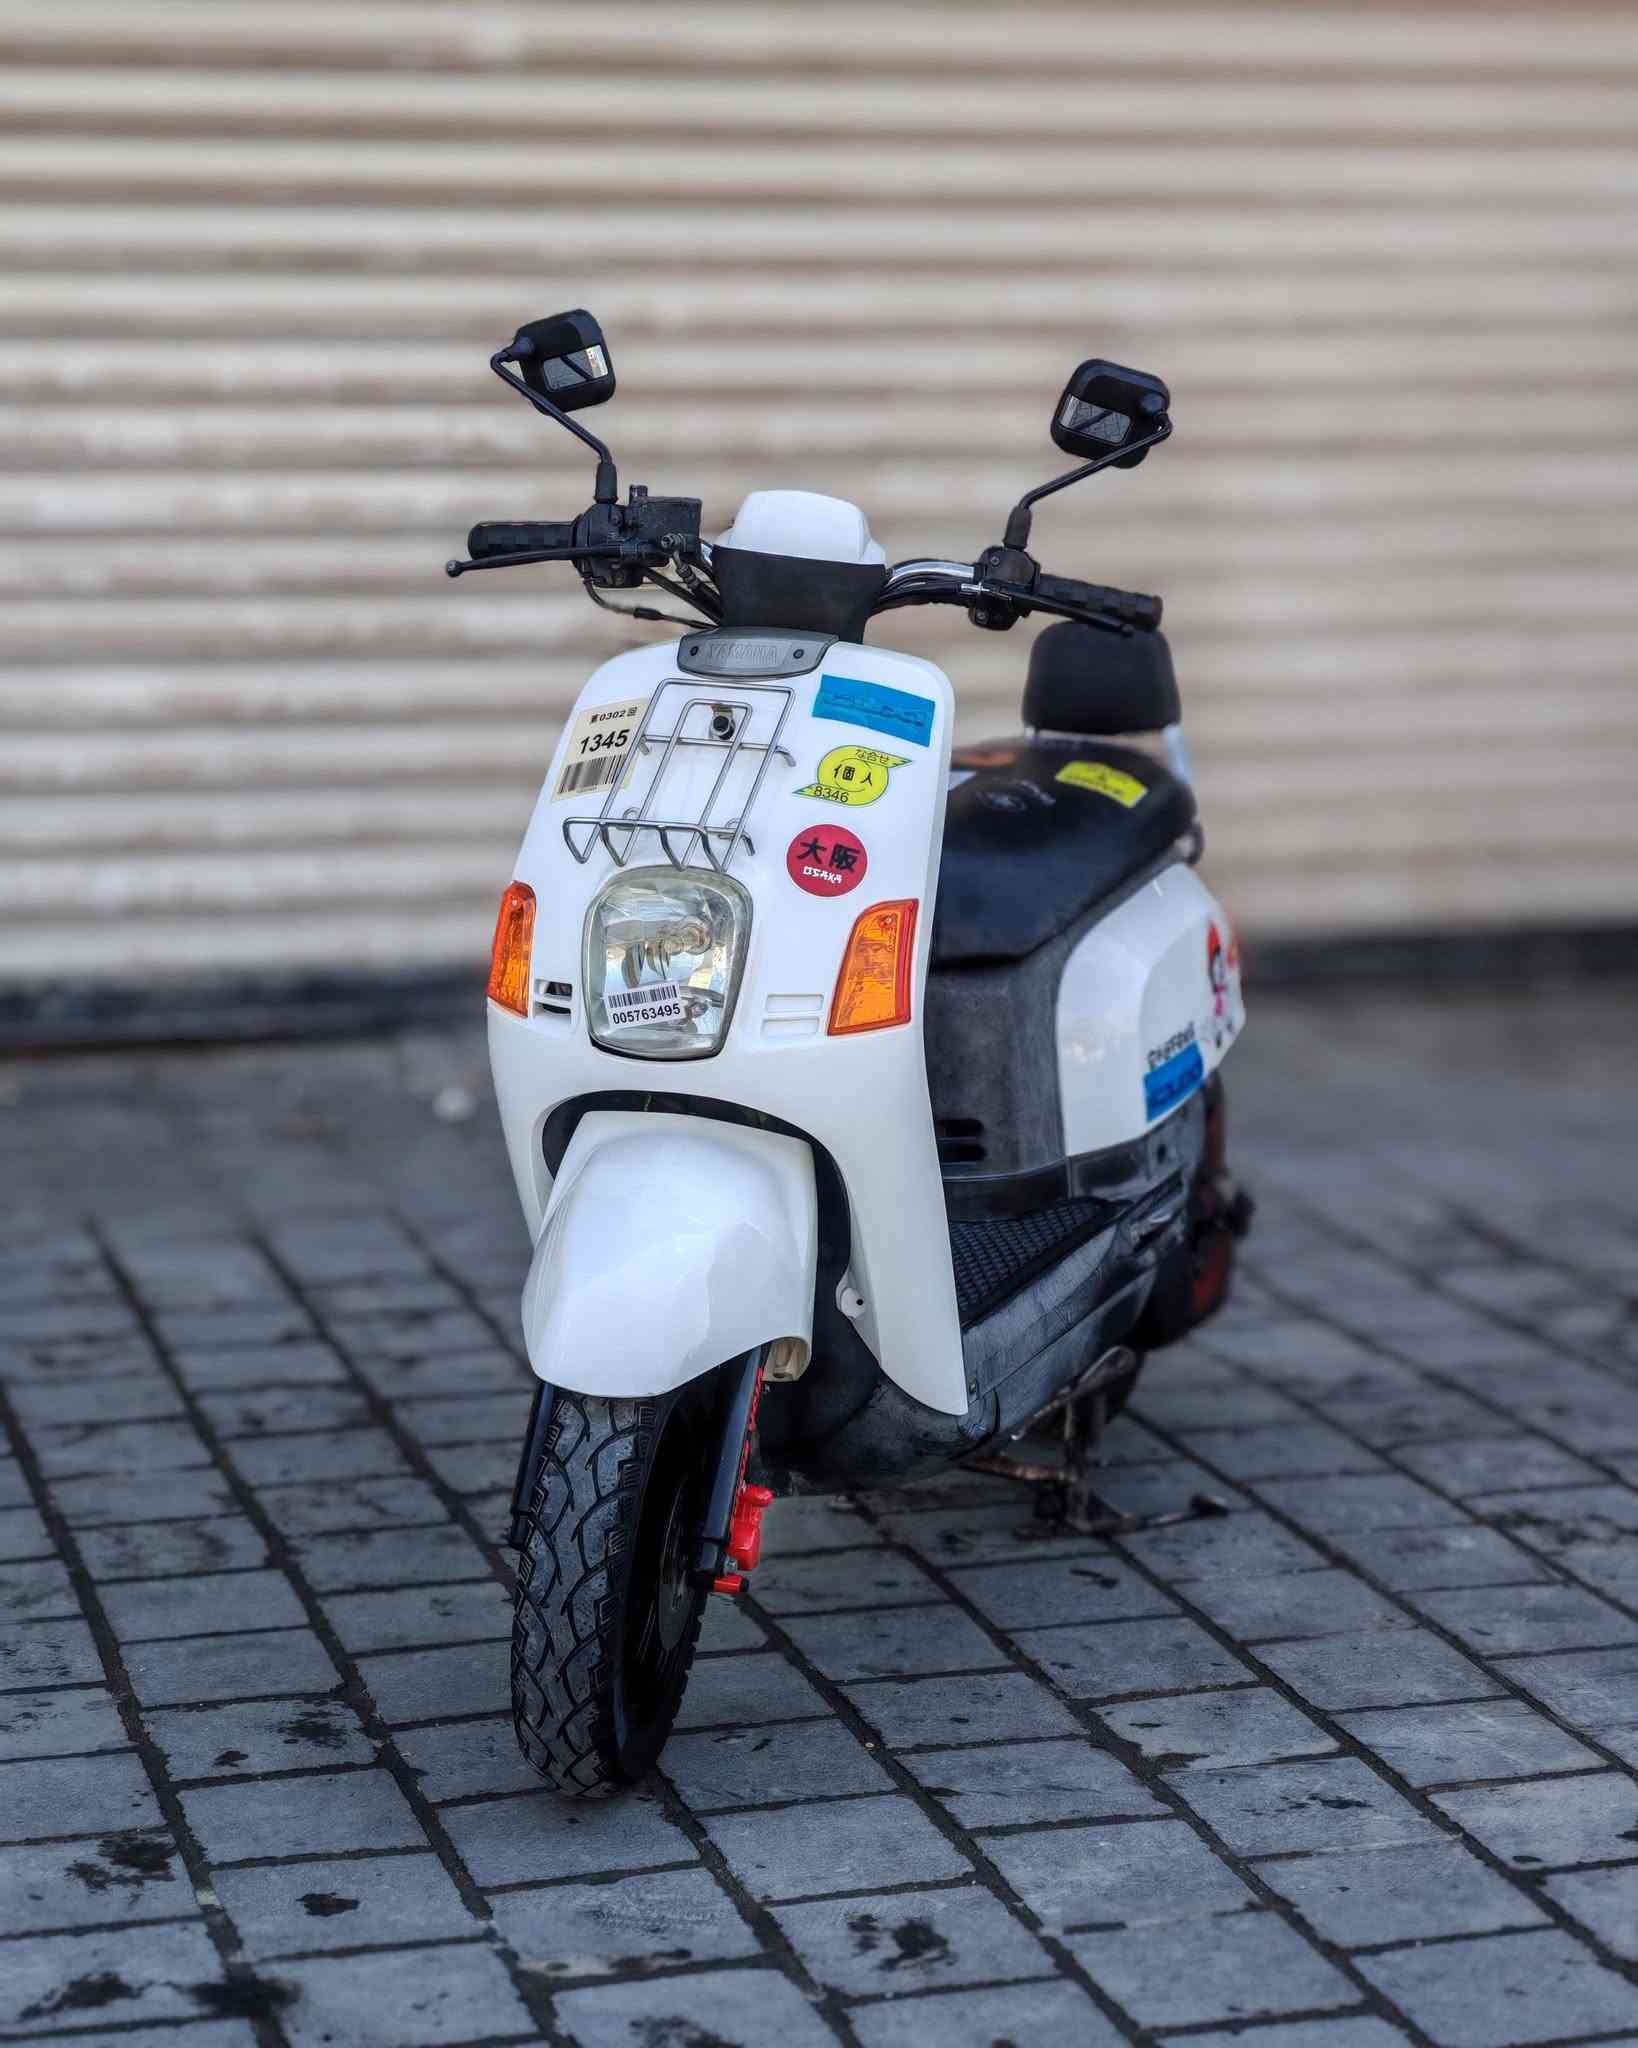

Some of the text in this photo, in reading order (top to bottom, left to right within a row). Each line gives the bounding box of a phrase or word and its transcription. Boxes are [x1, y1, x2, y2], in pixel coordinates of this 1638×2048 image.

[580, 728, 630, 755] 1345
[833, 763, 873, 786] 個人
[813, 785, 850, 803] 8346
[797, 837, 861, 873] 大阪
[612, 1003, 681, 1024] 005763495
